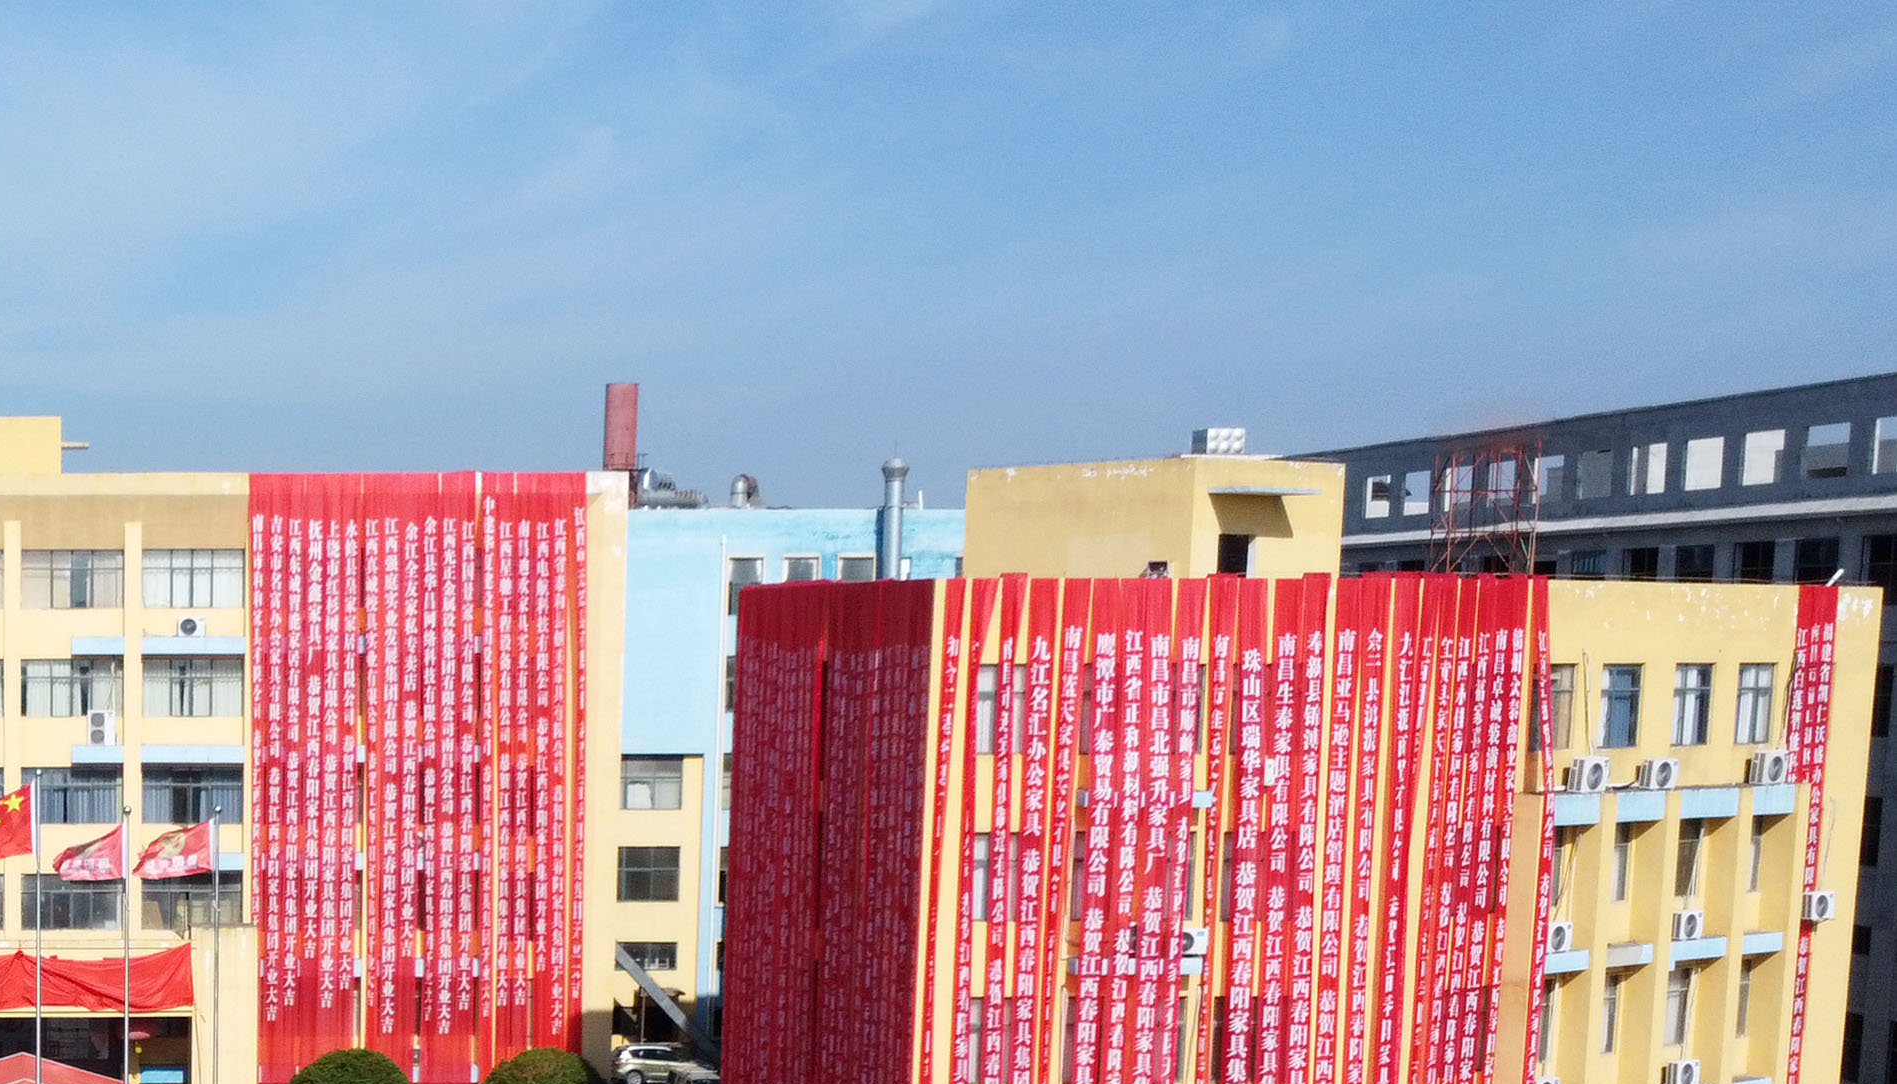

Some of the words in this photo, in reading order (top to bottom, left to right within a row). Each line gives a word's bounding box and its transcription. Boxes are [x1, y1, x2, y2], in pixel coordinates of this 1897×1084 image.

[266, 766, 280, 1020] 恭贺江西春阳家具集团开业大吉
[283, 751, 299, 1005] 恭贺江西春阳家具集团开业大吉
[303, 674, 321, 958] 恭贺江西春阳家具集团开业大吉
[319, 753, 338, 1007] 恭贺江西春阳家具集团开业大吉
[338, 735, 355, 989] 恭贺江西春阳家具集团开业大吉
[380, 783, 397, 1033] 恭贺江西春阳家具集团开业大吉
[400, 699, 417, 956] 恭贺江西春阳家具集团开业大吉
[438, 823, 454, 1033] 恭贺江西春阳家具集团开业大吉
[457, 734, 473, 1010] 恭贺江西春阳家具集团开业大吉
[497, 753, 510, 1005] 恭贺江西春阳家具集团开业大吉
[515, 753, 527, 1005] 恭贺江西春阳家具集团开业大吉
[535, 717, 548, 970] 恭贺江西春阳家具集团开业大吉
